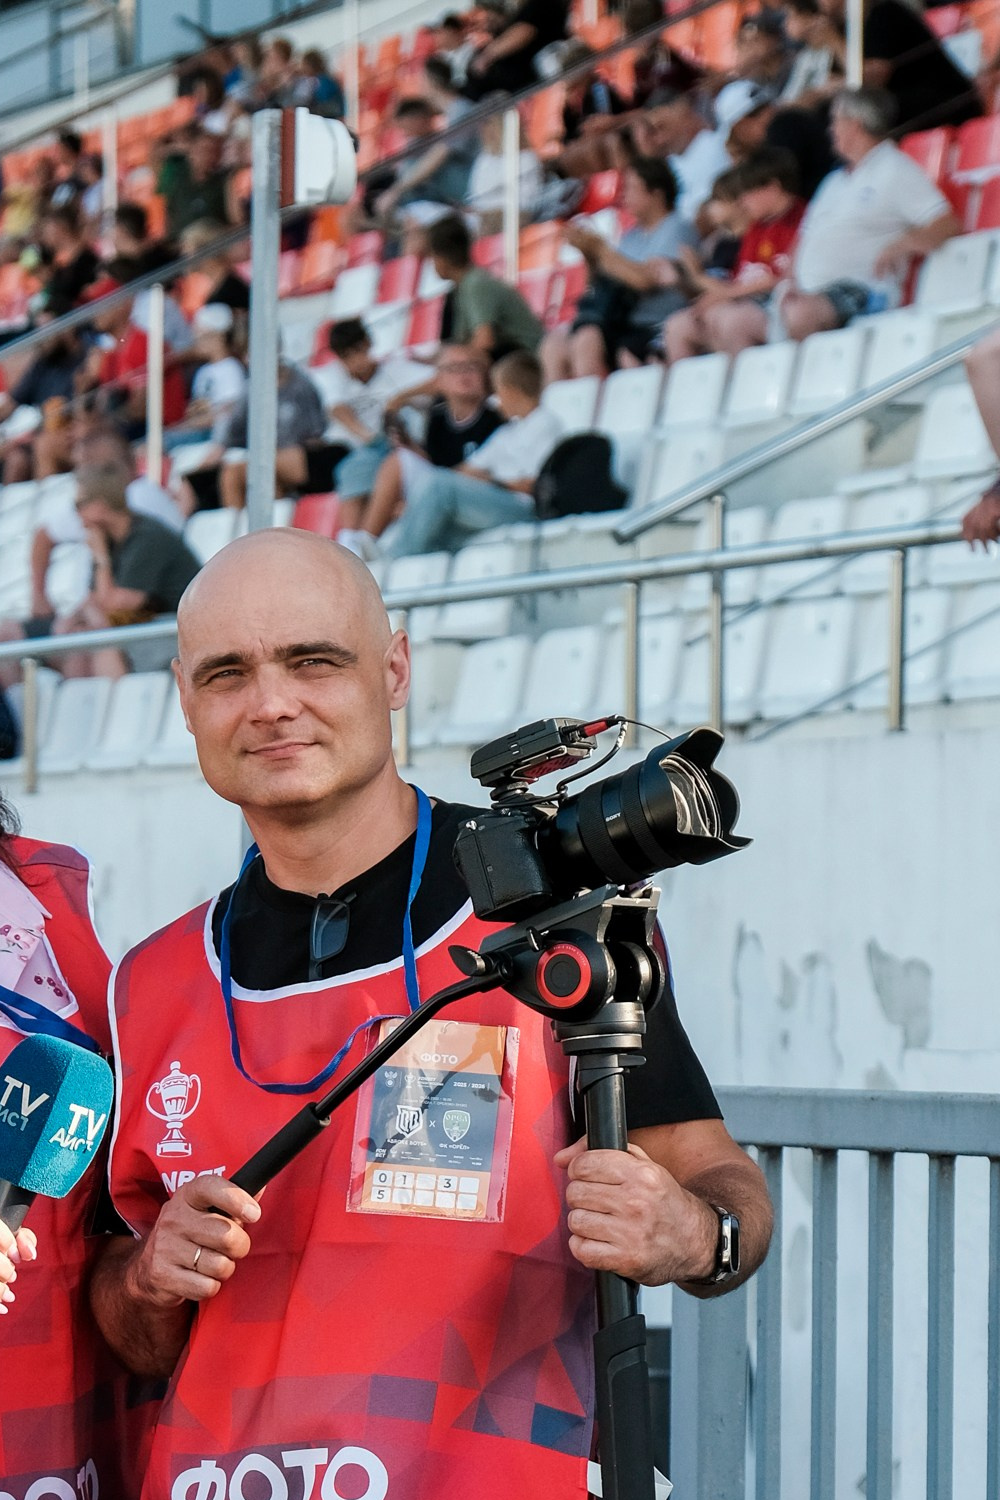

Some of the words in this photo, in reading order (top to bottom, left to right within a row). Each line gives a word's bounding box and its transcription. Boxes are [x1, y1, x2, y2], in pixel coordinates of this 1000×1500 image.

[420, 1052, 459, 1065] ФОТО
[4, 1075, 50, 1117] TV
[69, 1103, 106, 1141] TV
[378, 1173, 387, 1183] 0
[402, 1175, 407, 1185] 1
[443, 1178, 451, 1188] 3
[376, 1190, 385, 1200] 5
